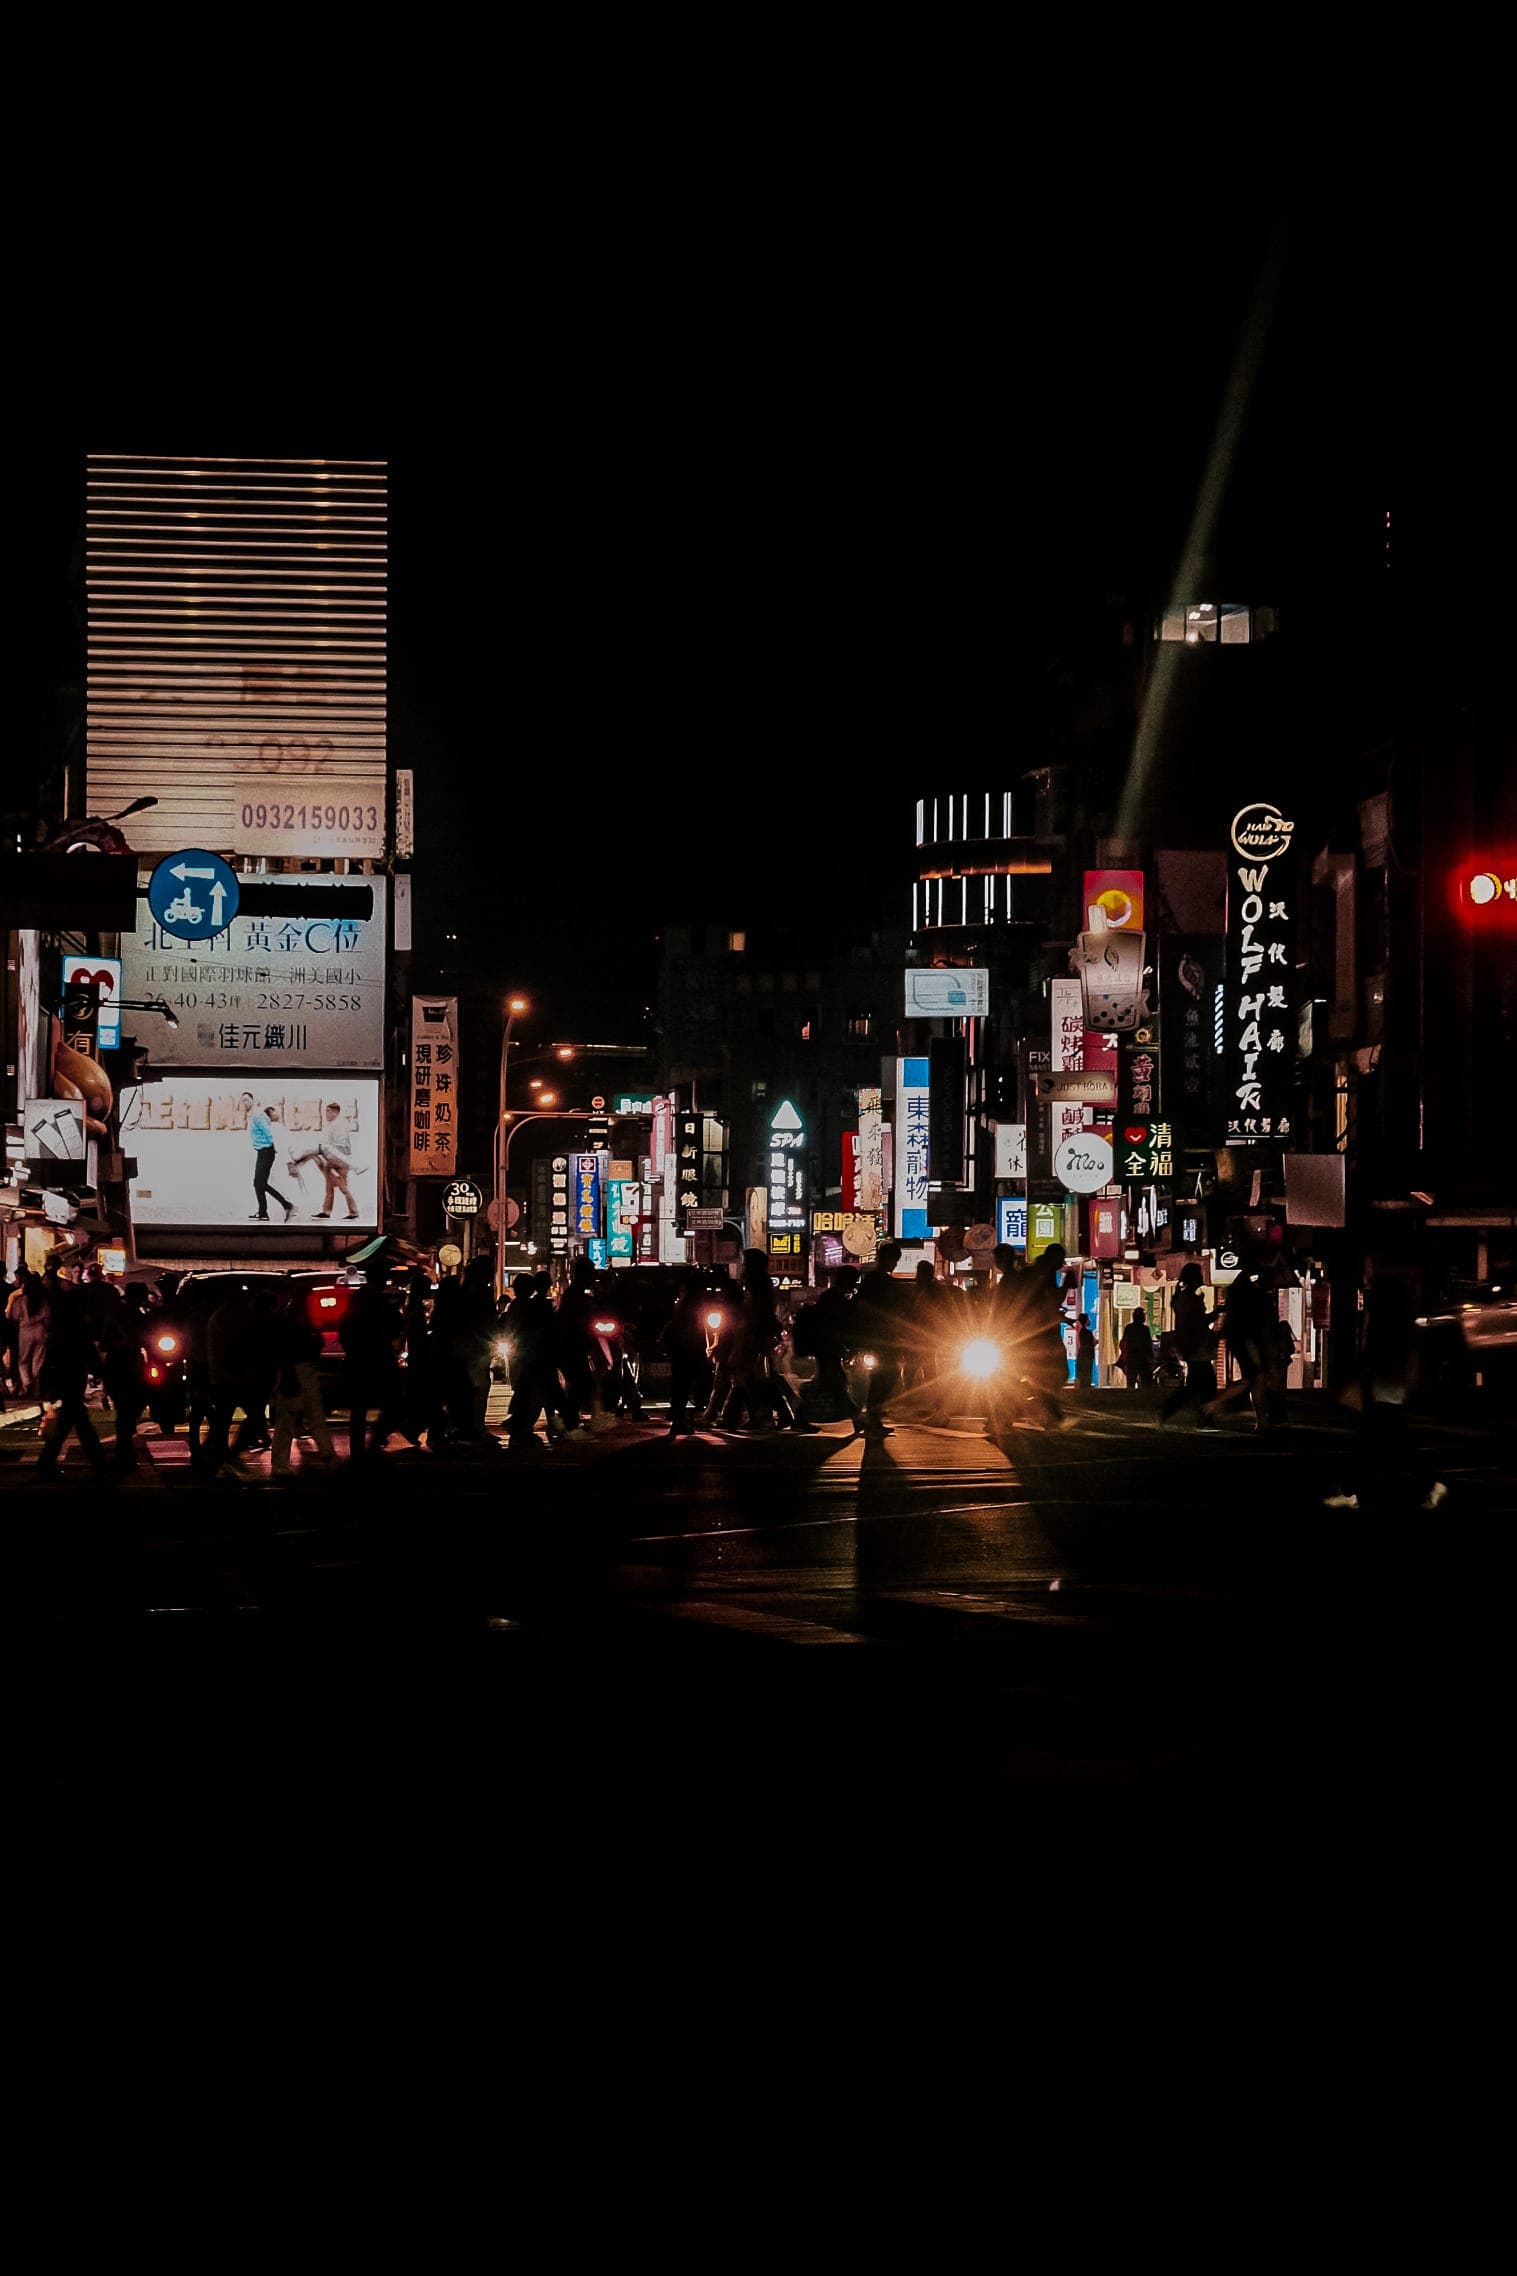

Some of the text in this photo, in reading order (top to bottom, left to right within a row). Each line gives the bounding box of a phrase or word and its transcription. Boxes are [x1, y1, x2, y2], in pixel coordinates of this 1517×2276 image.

[242, 804, 378, 831] 0932159033
[243, 921, 364, 954] 黃金C位
[145, 965, 361, 985] 正對國際羽球館 洲美國小
[1235, 865, 1268, 1110] WOLF HAIR
[257, 993, 361, 1010] 2827-5858
[219, 1023, 307, 1050] 佳元織川
[1029, 1051, 1050, 1063] FIX
[414, 1043, 432, 1152] 現研磨咖啡
[434, 1043, 452, 1152] 珍珠奶茶
[1057, 1081, 1081, 1091] JUST
[769, 1133, 804, 1148] SPA
[450, 1183, 470, 1196] 30
